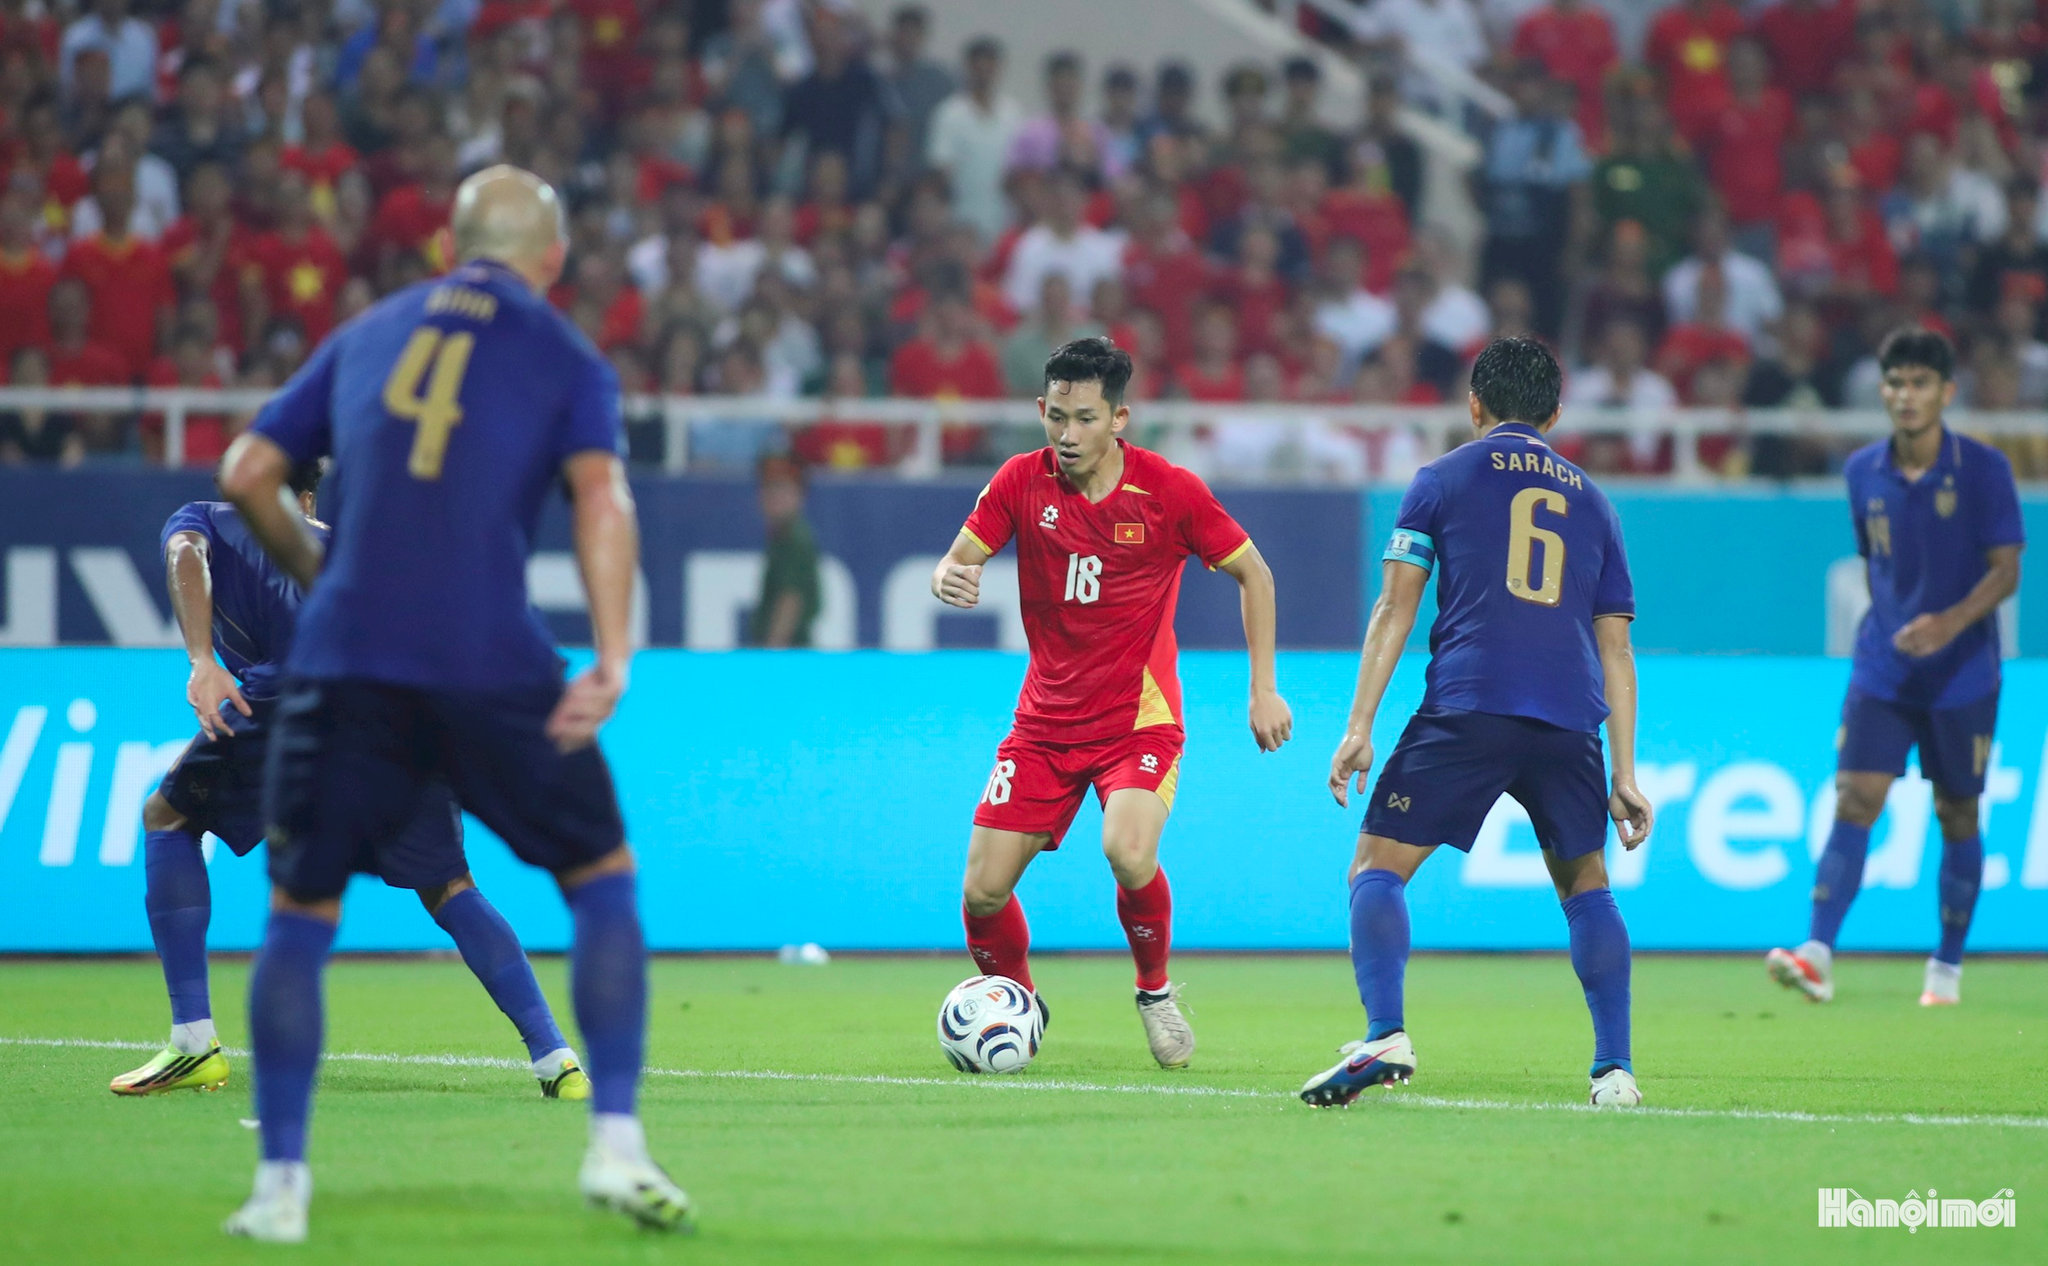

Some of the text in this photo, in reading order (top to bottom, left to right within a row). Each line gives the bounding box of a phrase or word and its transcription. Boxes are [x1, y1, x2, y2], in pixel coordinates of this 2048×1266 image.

[382, 325, 474, 480] 4
[1490, 451, 1583, 491] SARACH
[1506, 487, 1567, 607] 6
[1064, 552, 1103, 604] 18
[980, 758, 1017, 806] 18
